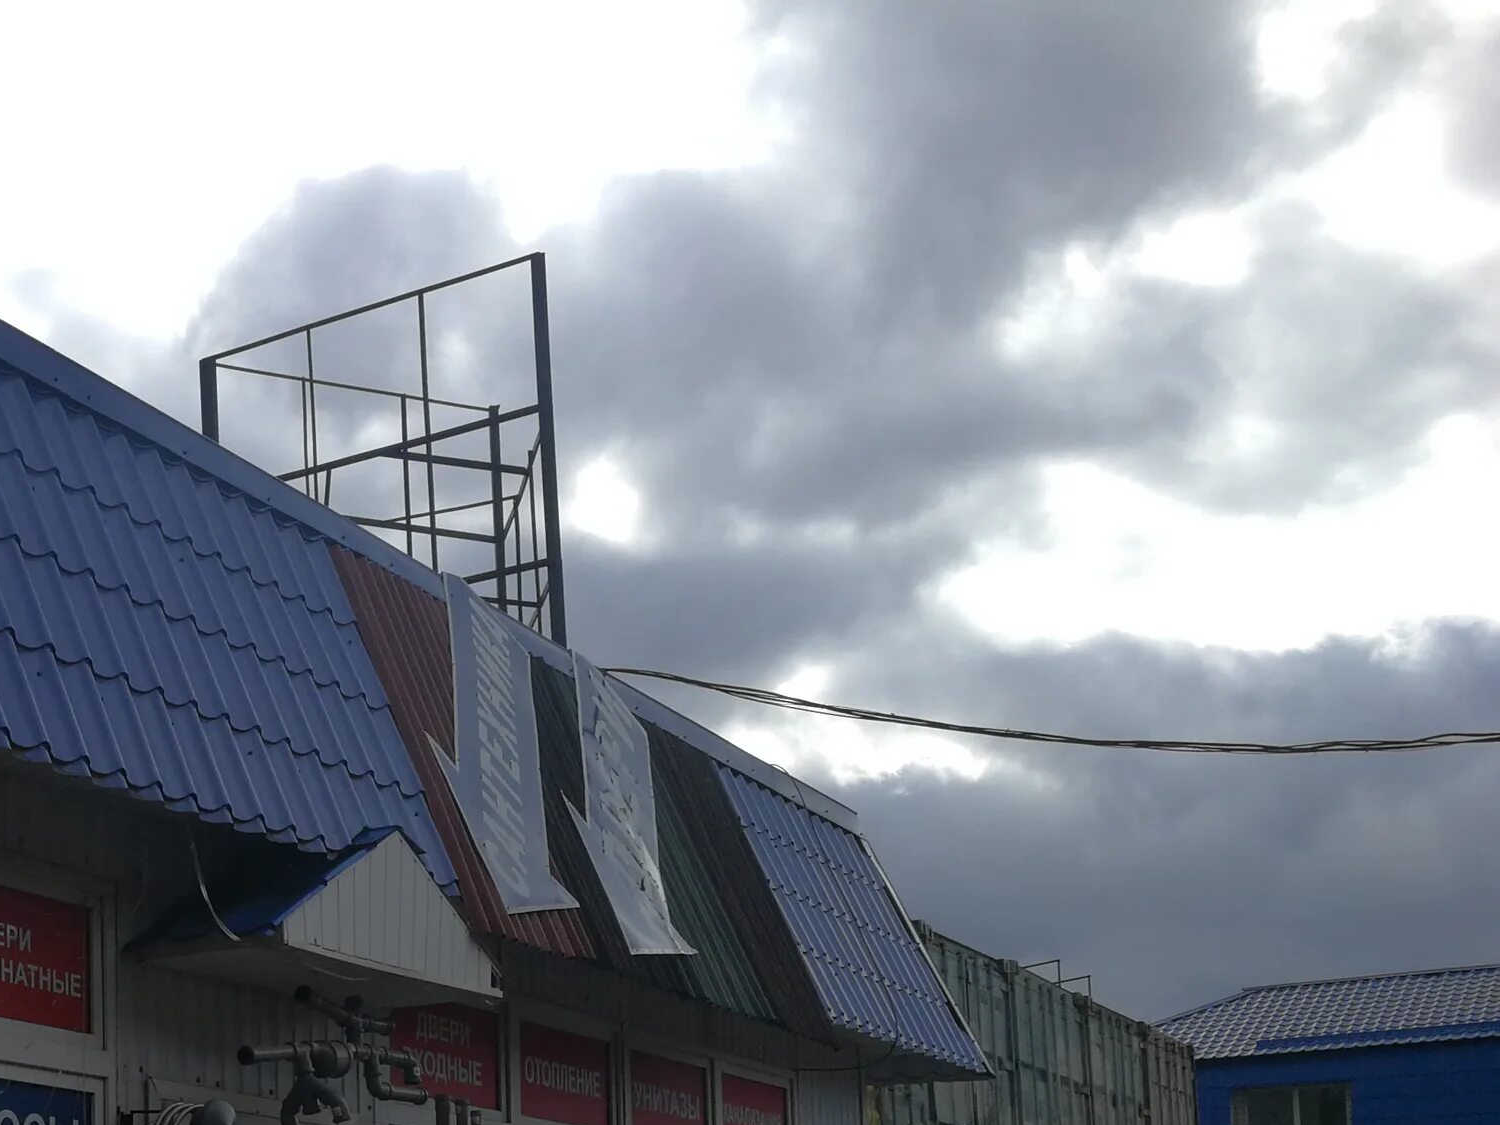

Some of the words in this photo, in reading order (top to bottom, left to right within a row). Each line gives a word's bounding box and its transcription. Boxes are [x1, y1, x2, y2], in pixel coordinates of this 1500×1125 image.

[416, 1011, 470, 1048] ДВЕРИ
[402, 1045, 483, 1086] ХОДНЫЕ
[525, 1056, 600, 1098] ОТОПЛЕНИЕ
[633, 1082, 700, 1121] УНИТАЗЫ
